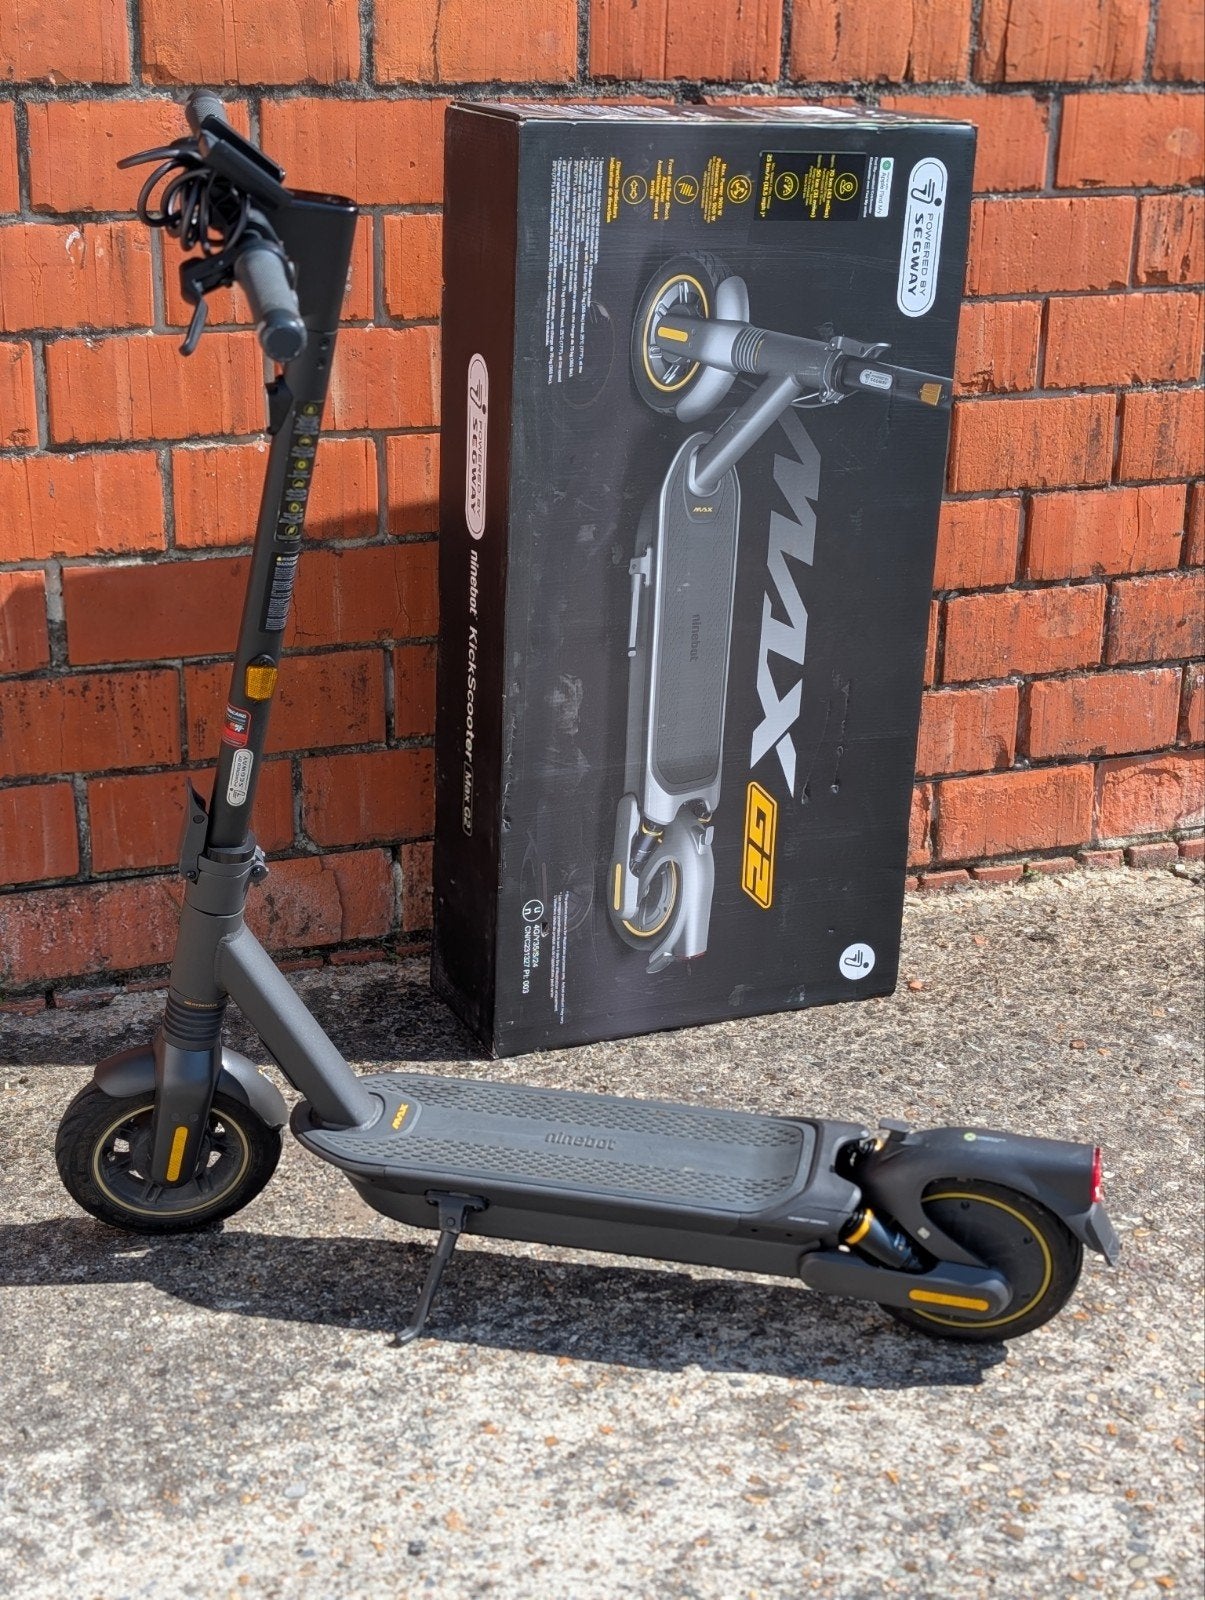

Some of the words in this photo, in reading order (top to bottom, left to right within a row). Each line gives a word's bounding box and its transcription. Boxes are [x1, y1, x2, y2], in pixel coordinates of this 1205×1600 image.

[814, 178, 819, 187] km
[828, 177, 833, 186] km
[876, 204, 882, 214] My
[907, 213, 924, 296] SEGWAY
[920, 213, 933, 275] POWERED
[918, 280, 926, 296] BY
[476, 497, 480, 518] BY
[469, 548, 479, 617] ninebot
[750, 404, 821, 798] MAX
[689, 614, 701, 662] ninebot
[465, 626, 476, 763] KickScooter
[463, 802, 471, 830] G2
[743, 785, 775, 905] G2
[392, 1104, 408, 1130] MAX
[544, 1132, 616, 1150] ninebot
